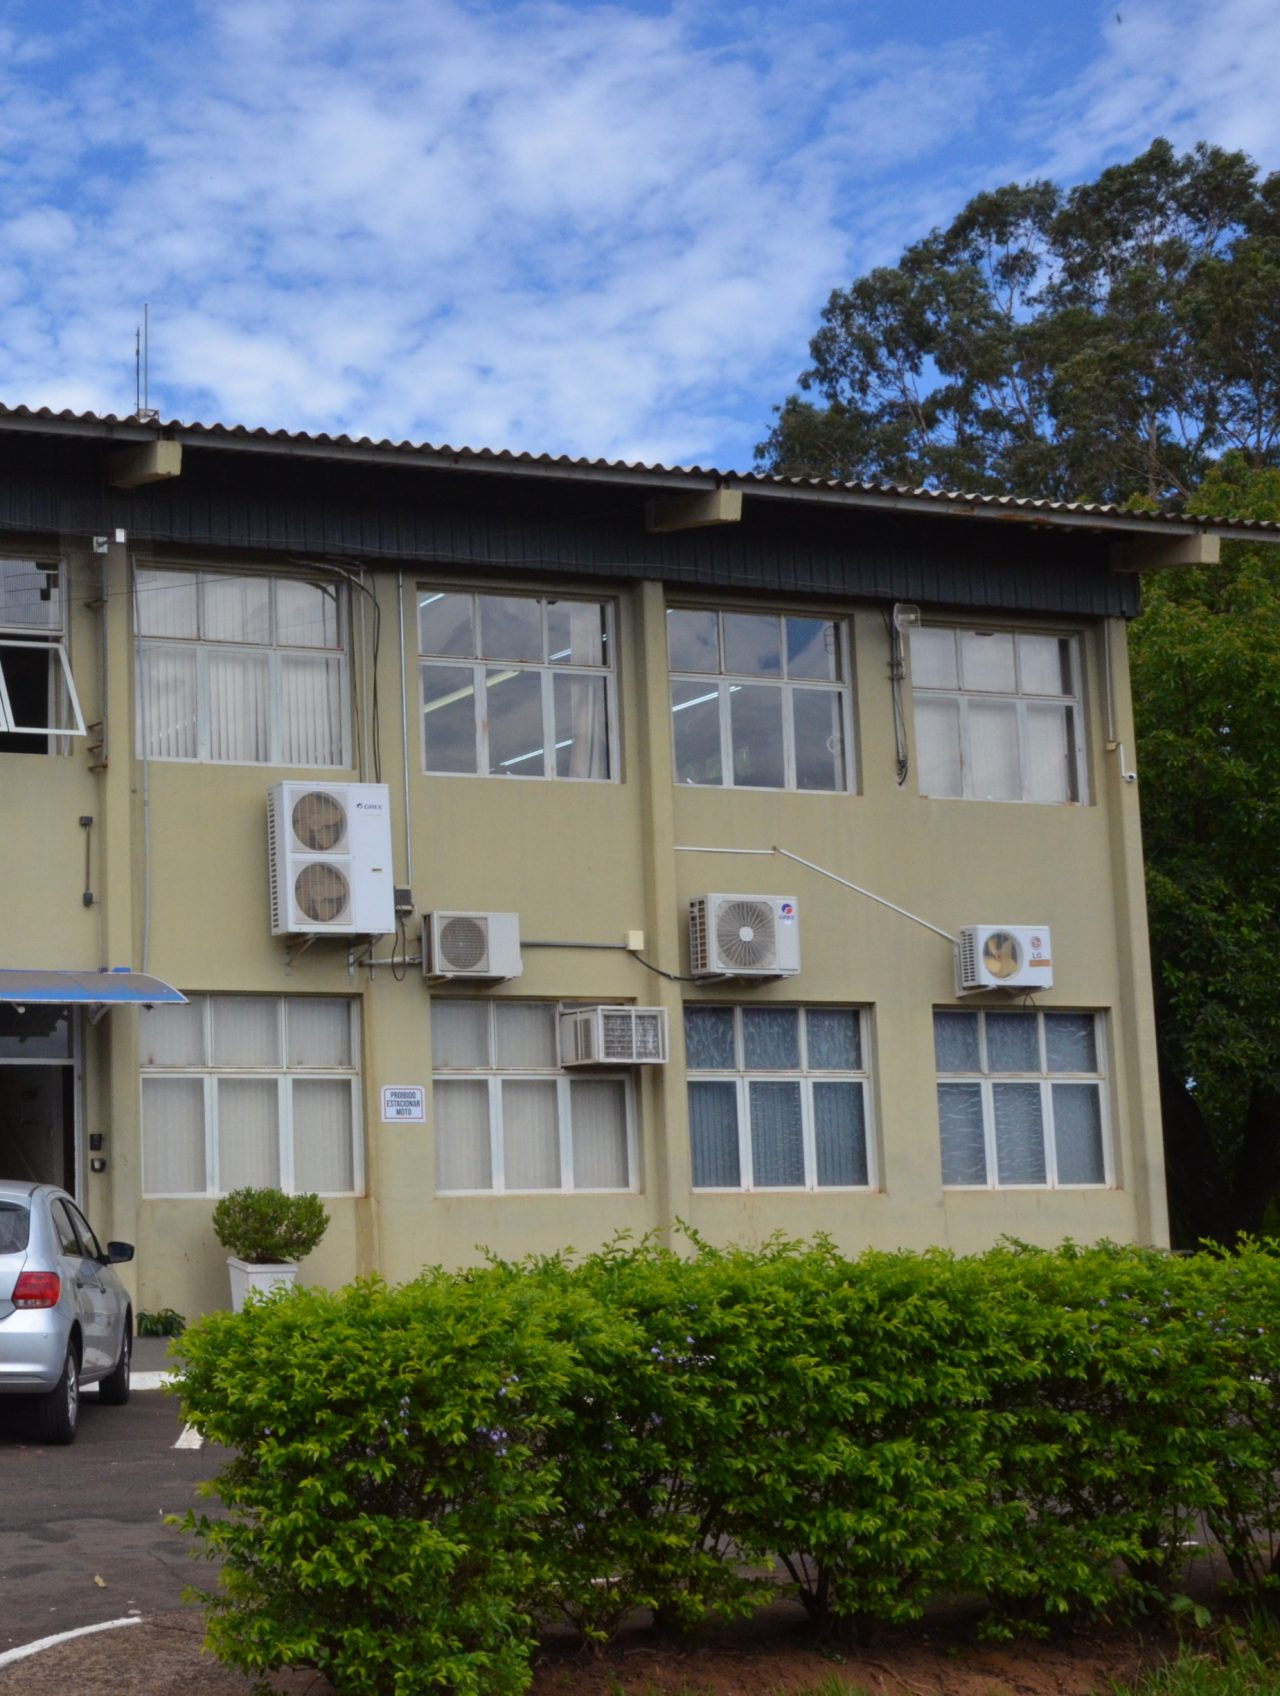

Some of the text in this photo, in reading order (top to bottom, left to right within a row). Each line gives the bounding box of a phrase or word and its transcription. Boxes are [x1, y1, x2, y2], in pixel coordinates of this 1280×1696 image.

[390, 1091, 417, 1099] PROIBIDO
[386, 1099, 421, 1107] ESTACIONAR
[396, 1108, 412, 1116] MOTO
